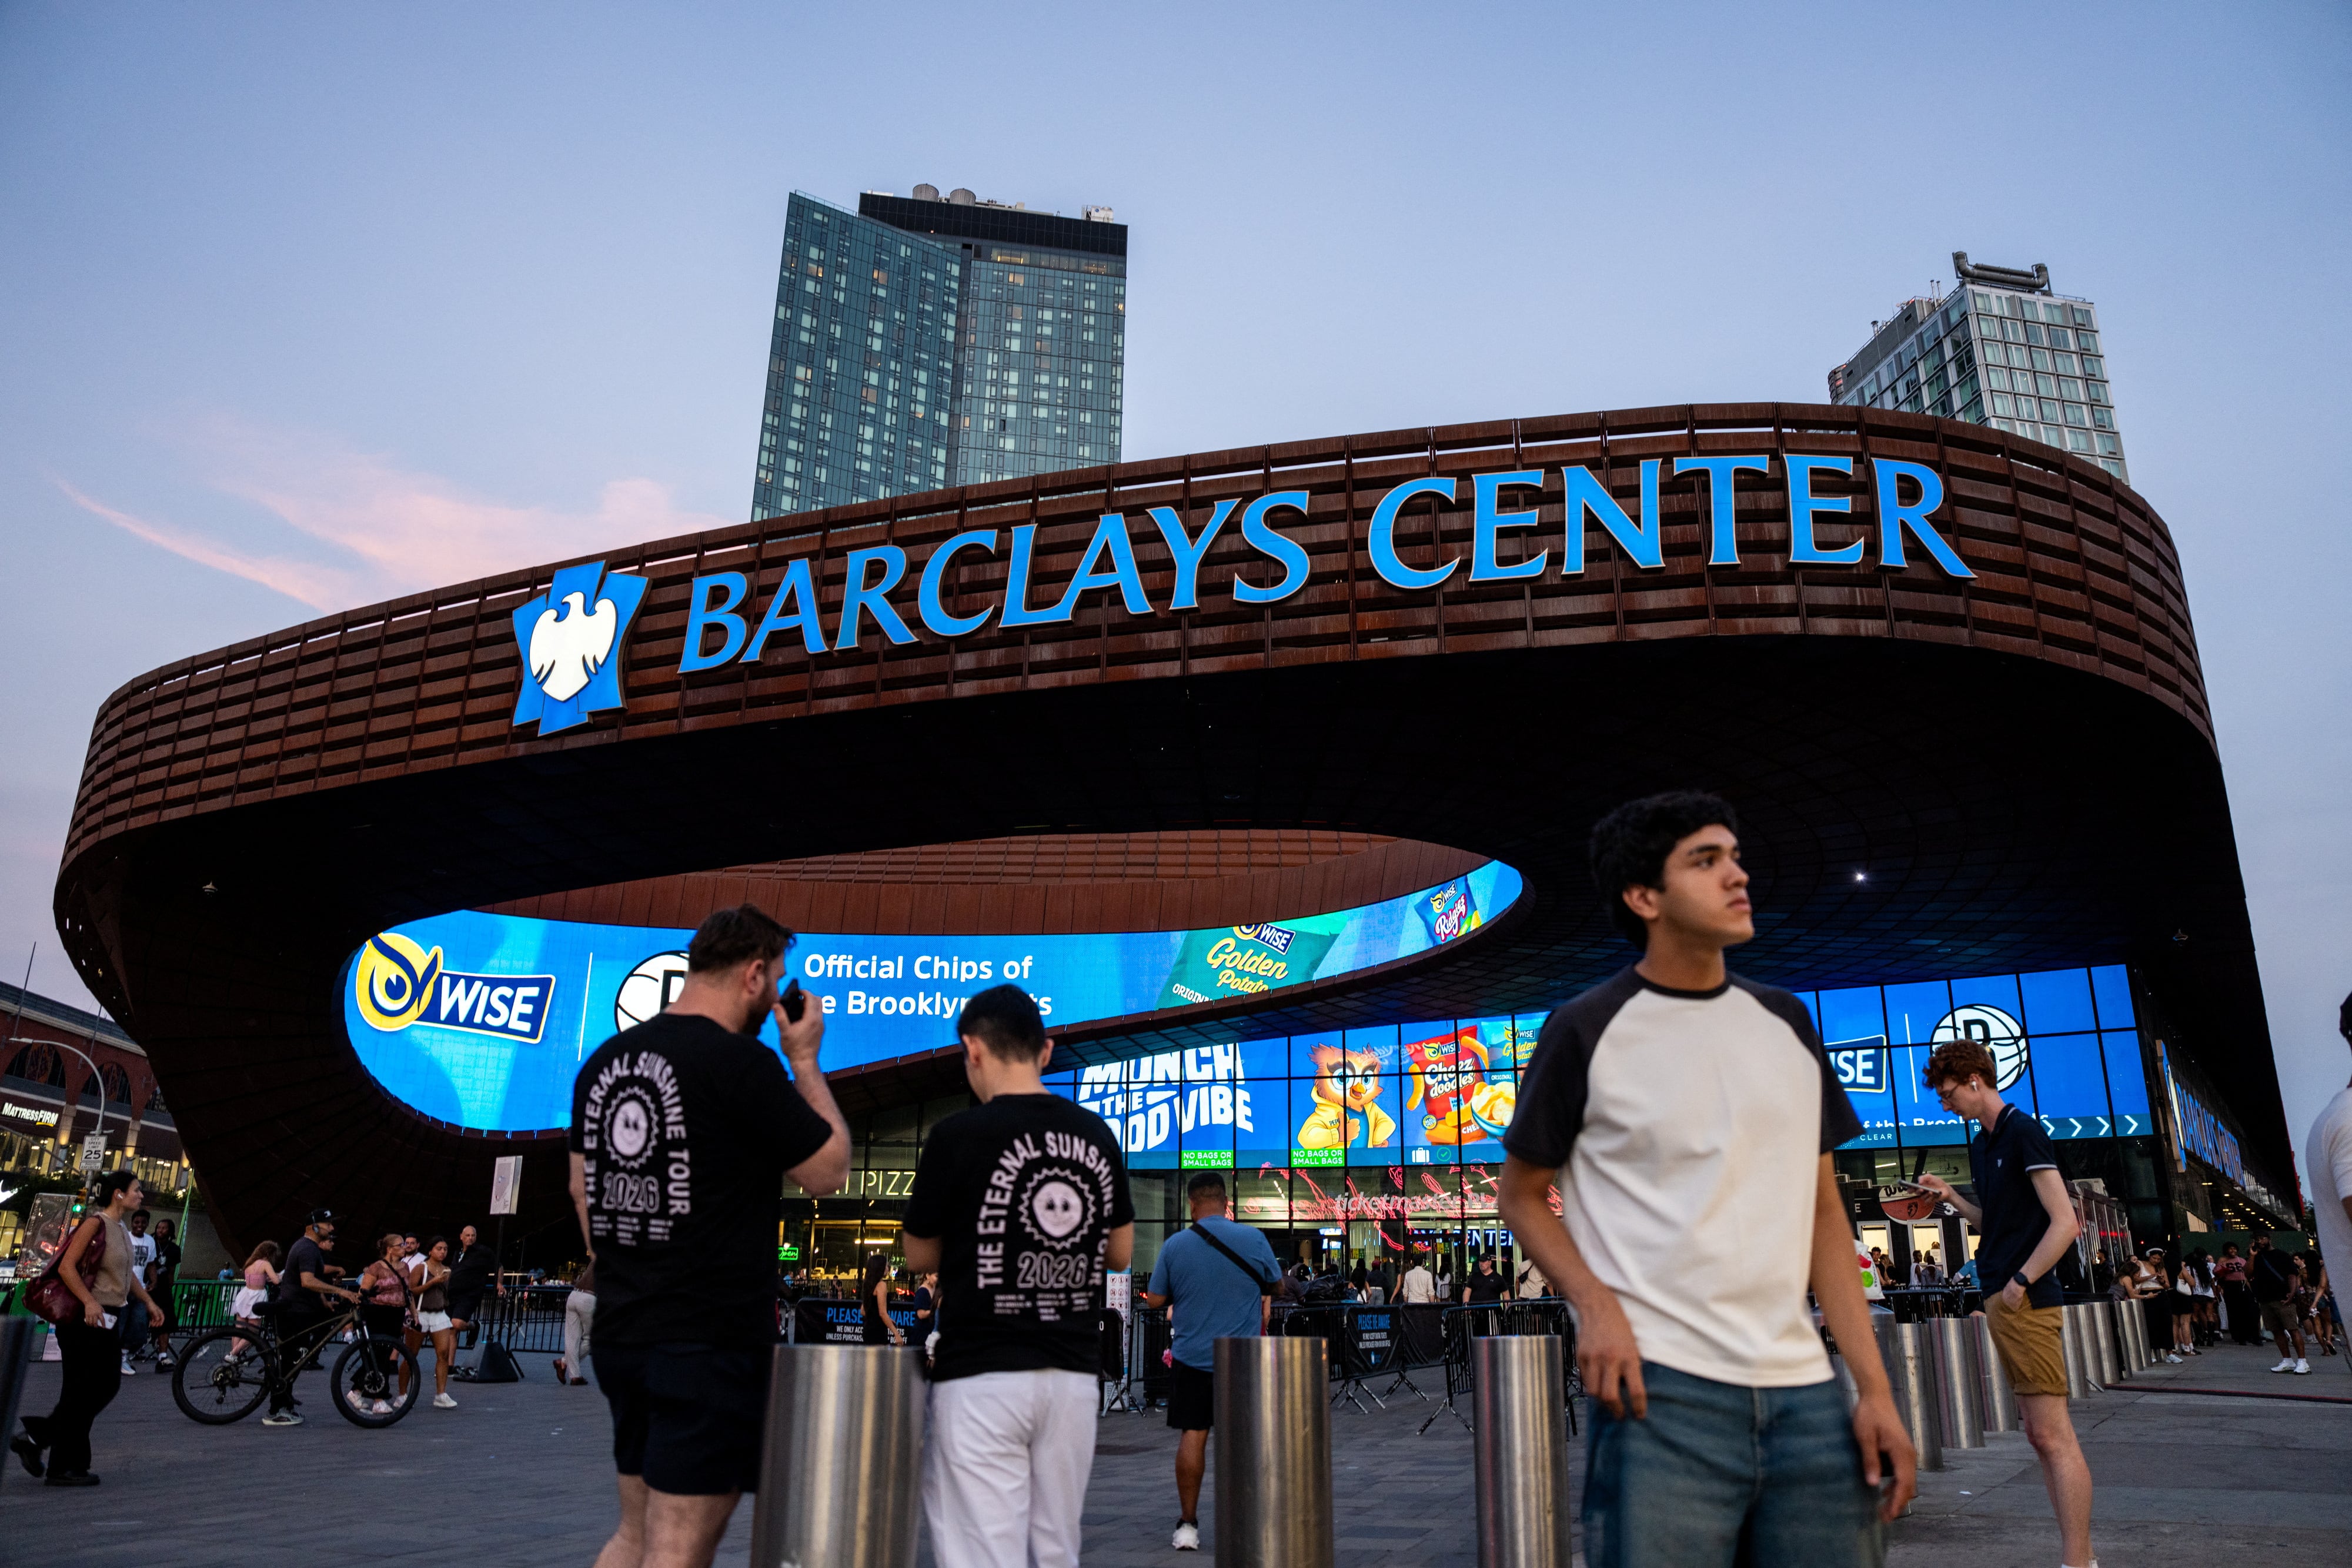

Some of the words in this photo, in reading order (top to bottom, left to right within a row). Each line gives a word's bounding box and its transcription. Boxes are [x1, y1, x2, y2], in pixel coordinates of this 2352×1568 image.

[677, 490, 1311, 674] BARCLAYS
[1368, 453, 1978, 589] CENTER
[1444, 884, 1456, 901] WISE
[1260, 925, 1291, 951] WISE
[1435, 894, 1466, 941] Ridgies
[804, 954, 903, 978] Official
[914, 955, 993, 982] Chips
[1003, 956, 1033, 979] of
[1207, 937, 1288, 979] Golden
[440, 975, 540, 1032] WISE
[1078, 1043, 1245, 1101] MUNCH
[583, 1052, 631, 1149] ETERNAL
[633, 1051, 687, 1140] SUNSHINE
[1102, 1092, 1143, 1116] THE
[1174, 1085, 1254, 1134] VIBE
[84, 1149, 101, 1159] 25
[1044, 1130, 1114, 1218] SUNSHINE
[583, 1159, 597, 1208] THE
[602, 1171, 660, 1213] 2026
[667, 1148, 691, 1215] TOUR
[860, 1171, 916, 1195] PIZZ
[977, 1132, 1042, 1235] ETERNAL
[1335, 1191, 1462, 1212] ticketmaster
[977, 1241, 1004, 1289] THE
[1017, 1251, 1088, 1289] 2026
[826, 1332, 842, 1340] UNLESS
[827, 1307, 863, 1324] PLEASE
[888, 1310, 916, 1327] WARE
